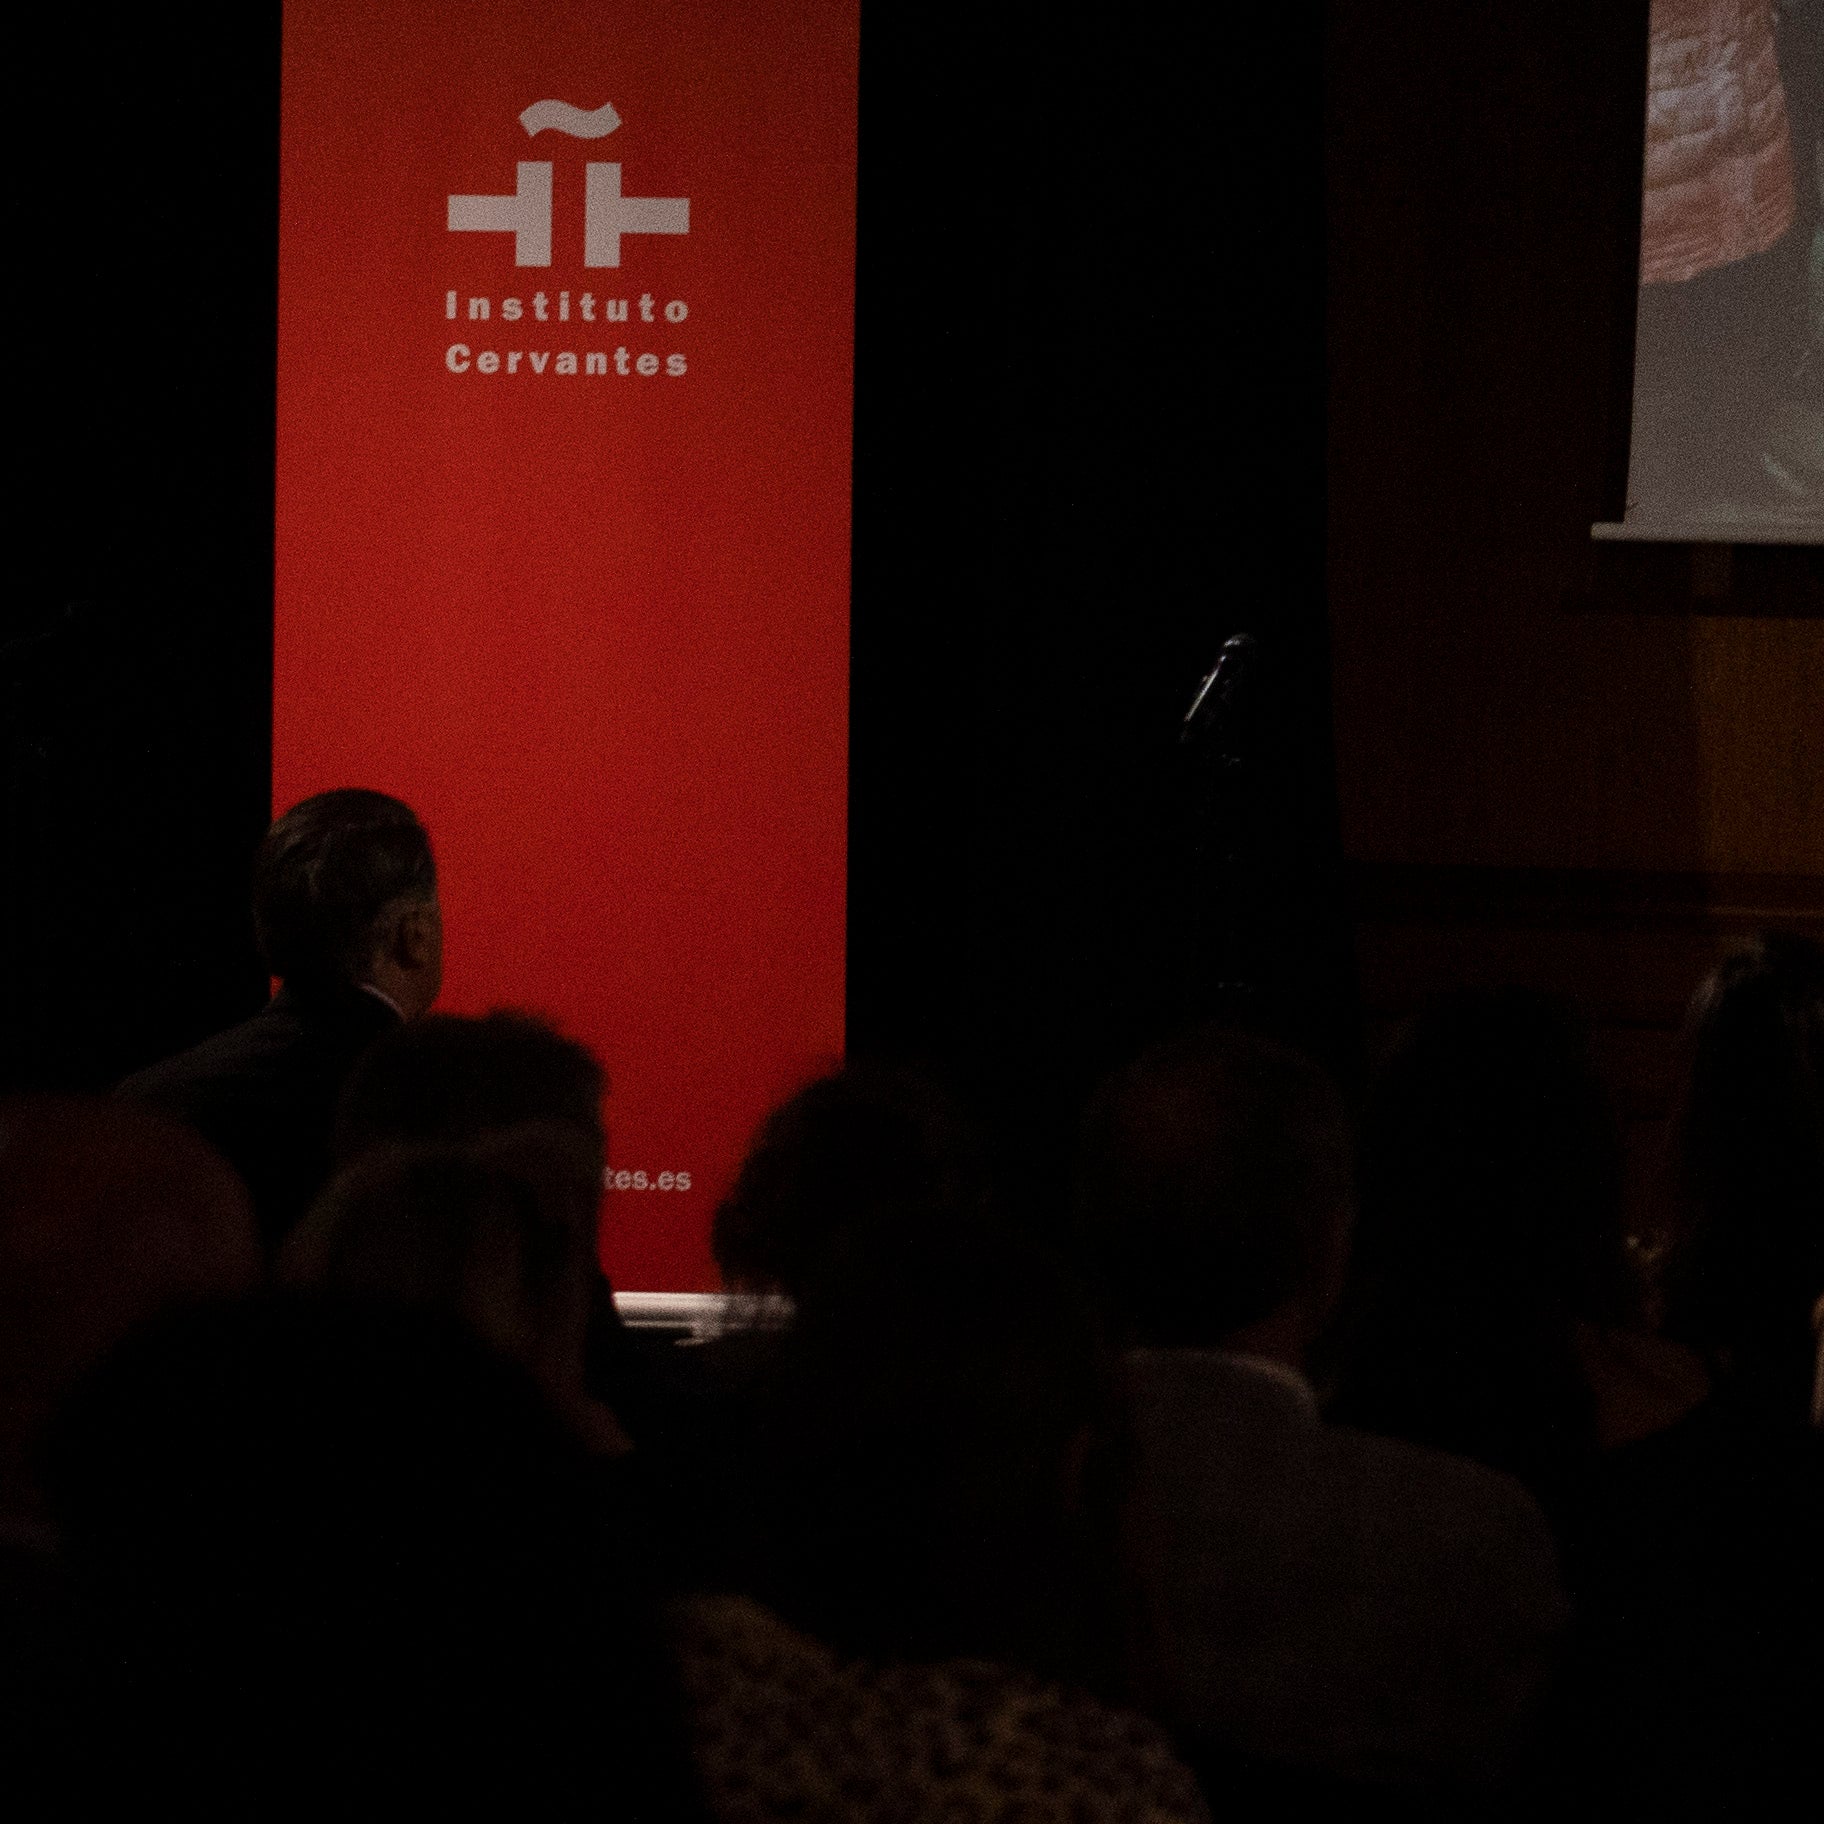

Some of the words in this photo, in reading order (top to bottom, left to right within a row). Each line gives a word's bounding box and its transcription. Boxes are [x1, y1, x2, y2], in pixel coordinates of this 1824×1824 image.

[446, 290, 689, 323] Instituto
[445, 343, 689, 376] Cervantes
[603, 1166, 692, 1192] tes.es
